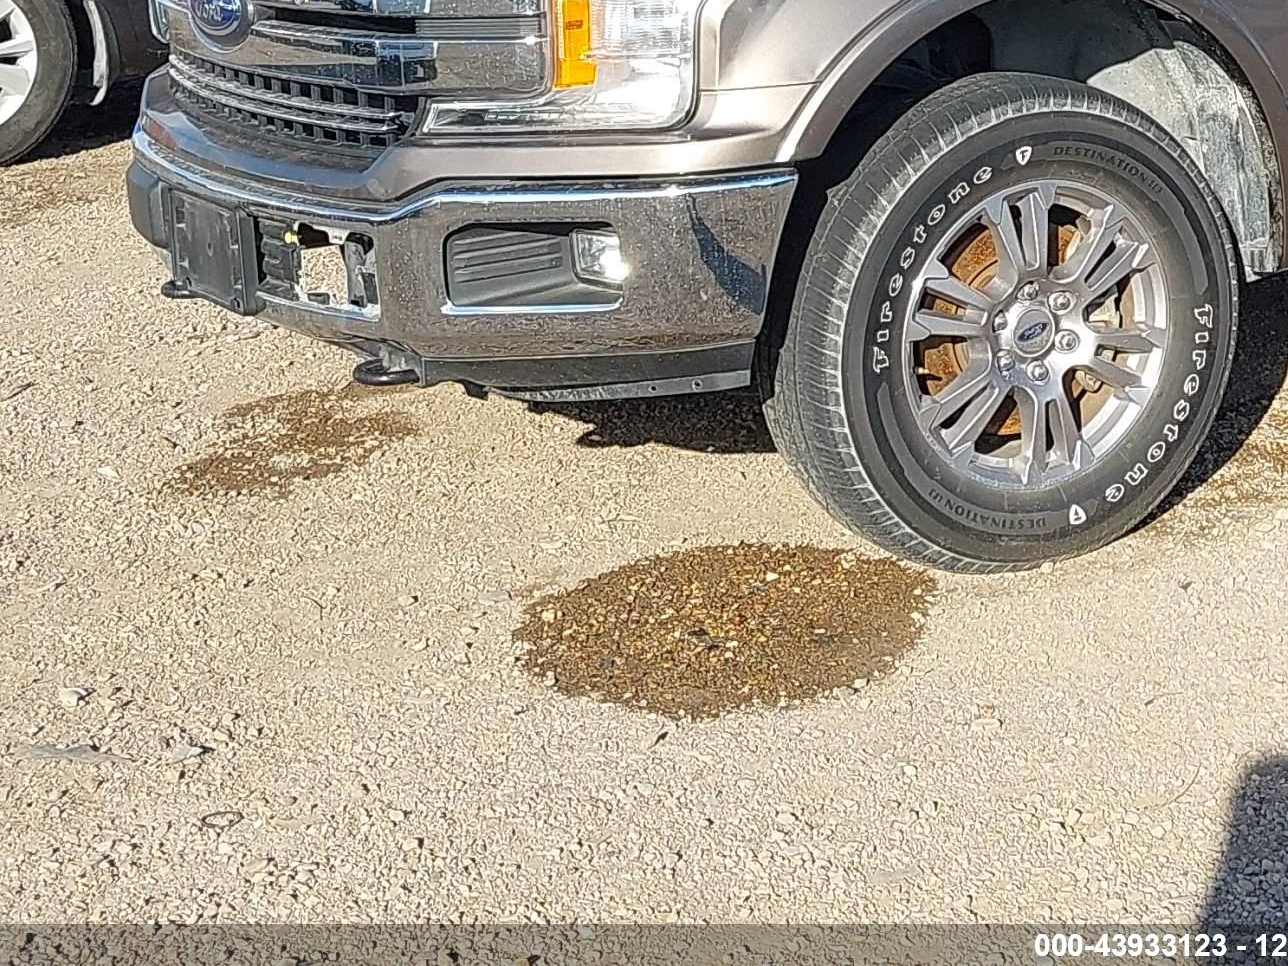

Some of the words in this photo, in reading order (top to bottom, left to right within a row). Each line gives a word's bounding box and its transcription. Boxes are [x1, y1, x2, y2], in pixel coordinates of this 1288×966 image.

[1053, 145, 1149, 183] DESTINATION
[872, 166, 993, 373] Firestone
[1104, 303, 1214, 502] Firestone
[943, 498, 1047, 530] DESTINATION
